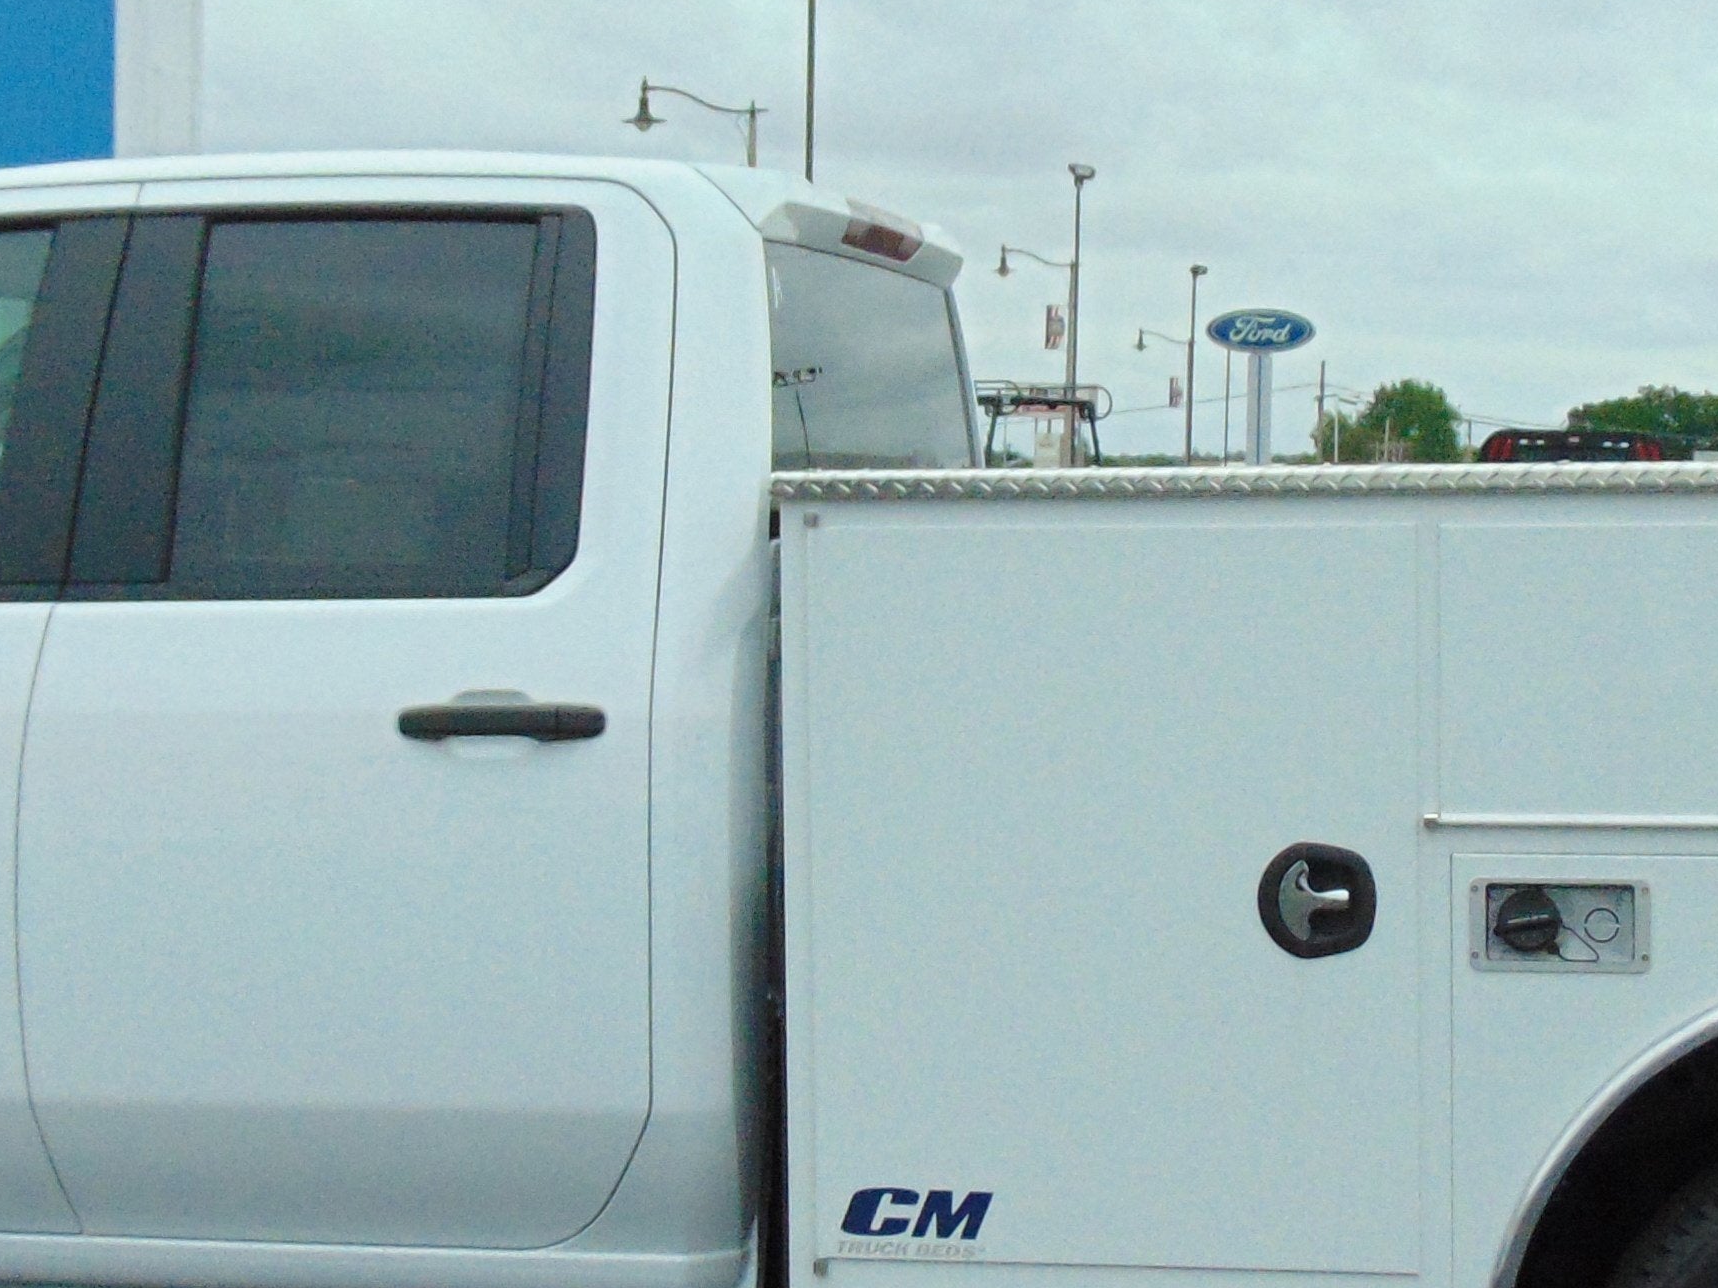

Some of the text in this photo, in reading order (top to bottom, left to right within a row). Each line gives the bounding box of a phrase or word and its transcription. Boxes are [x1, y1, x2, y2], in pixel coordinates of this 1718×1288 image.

[1229, 316, 1292, 343] Ford
[840, 1187, 993, 1240] CM
[837, 1241, 912, 1256] TRUCK
